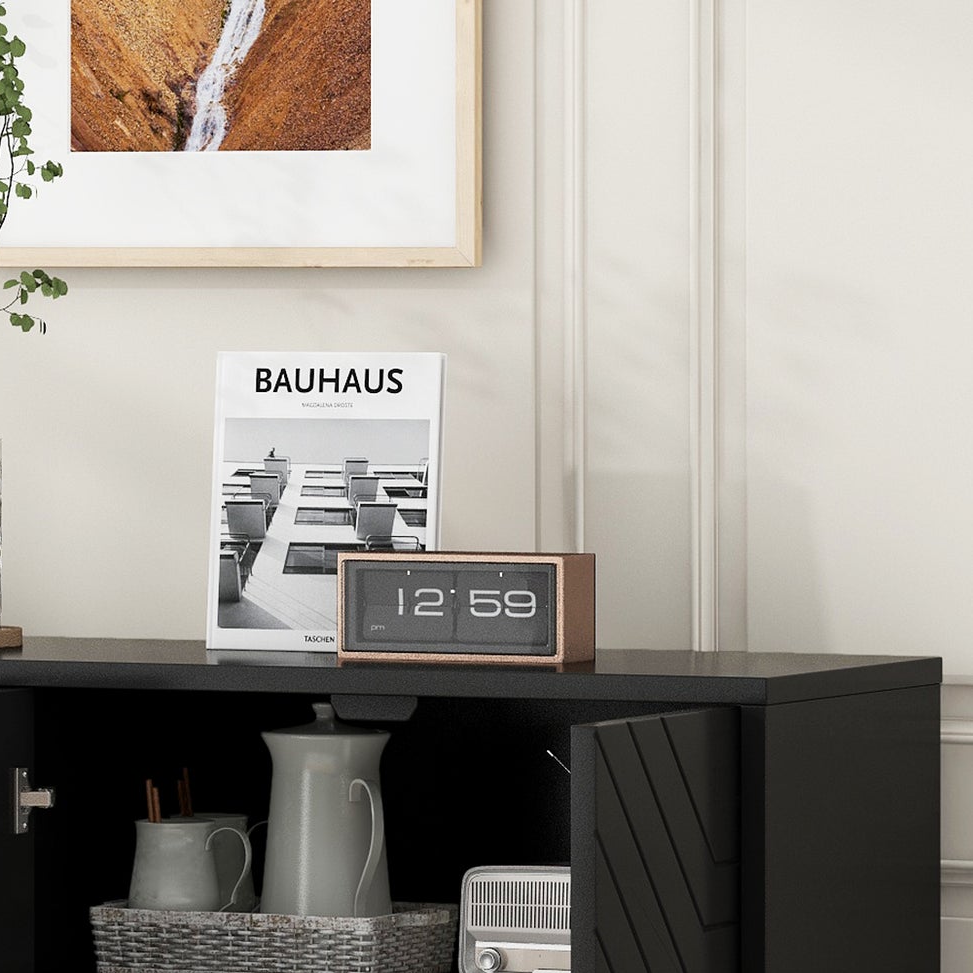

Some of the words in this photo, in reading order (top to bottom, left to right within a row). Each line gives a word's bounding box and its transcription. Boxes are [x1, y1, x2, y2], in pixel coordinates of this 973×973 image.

[255, 368, 404, 394] BAUHAUS
[371, 624, 385, 632] pm
[304, 635, 335, 643] TASCHEN
